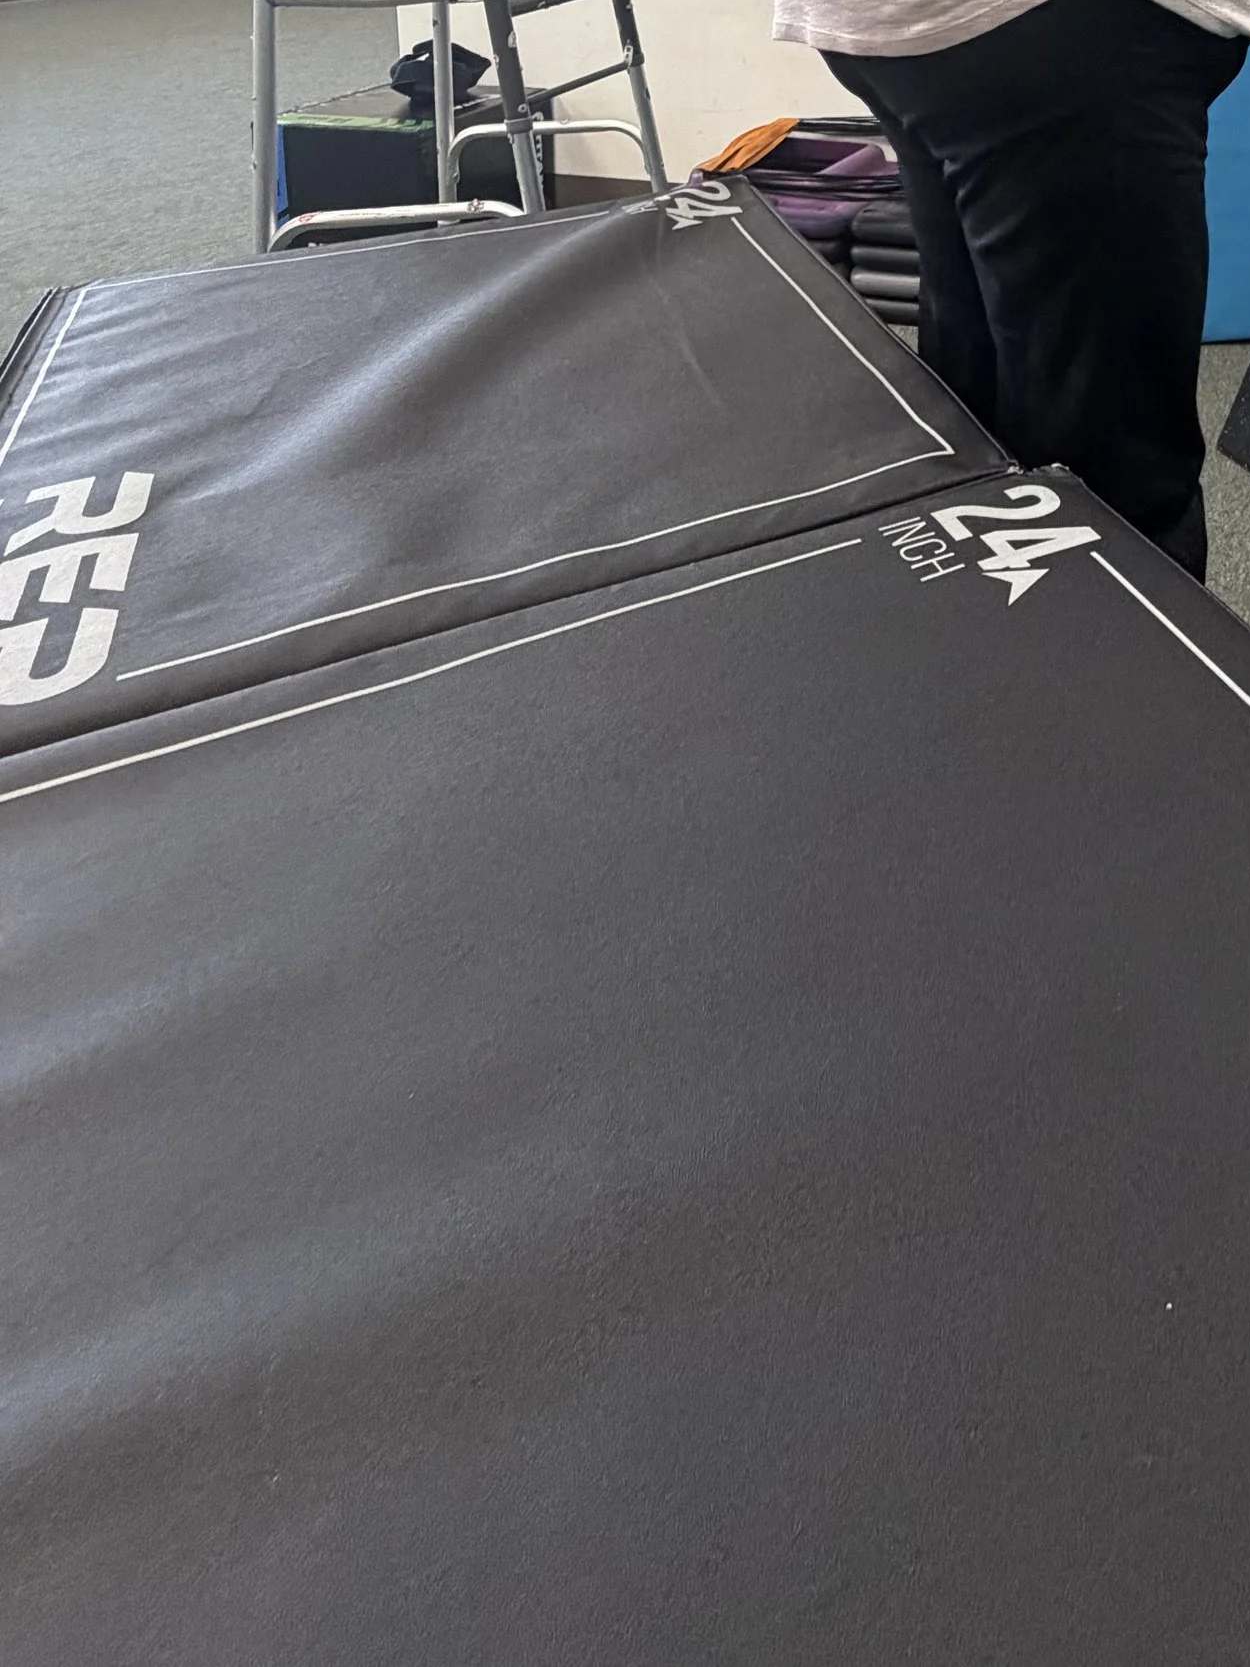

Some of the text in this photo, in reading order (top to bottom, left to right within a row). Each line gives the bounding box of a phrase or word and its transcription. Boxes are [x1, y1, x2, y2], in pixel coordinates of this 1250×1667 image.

[877, 516, 966, 583] INCH
[930, 484, 1102, 570] 24
[0, 472, 154, 706] REP
